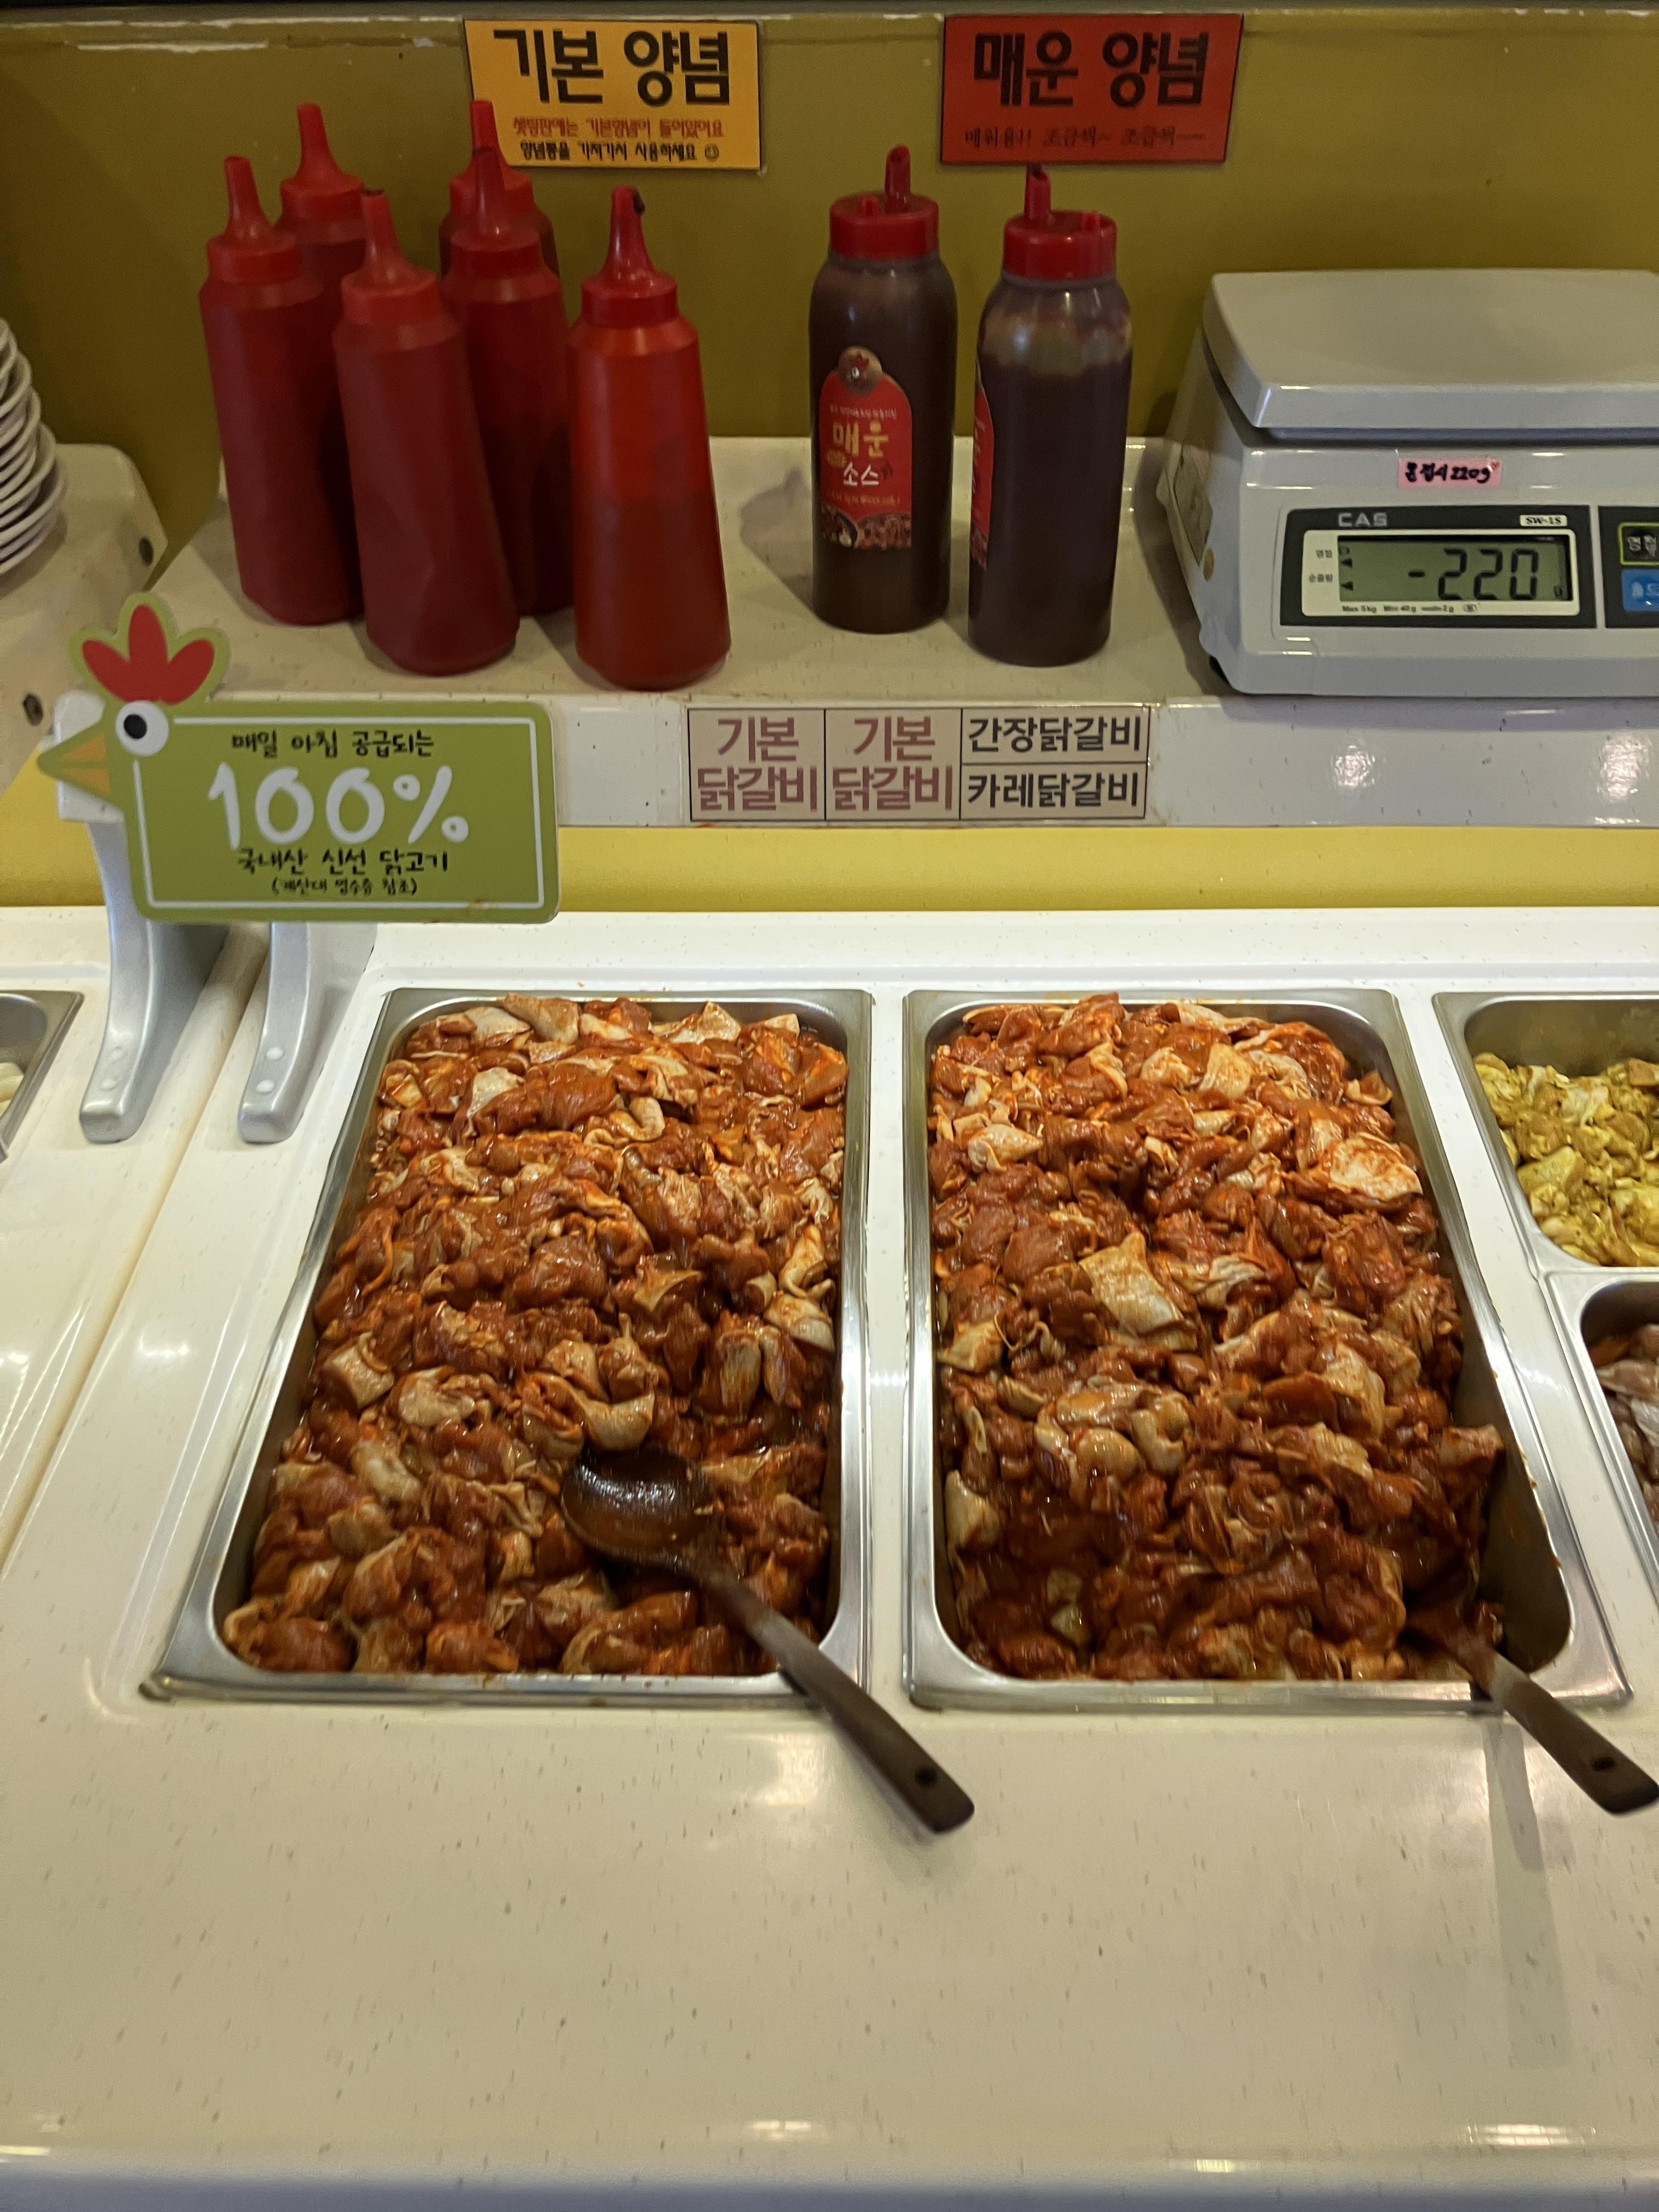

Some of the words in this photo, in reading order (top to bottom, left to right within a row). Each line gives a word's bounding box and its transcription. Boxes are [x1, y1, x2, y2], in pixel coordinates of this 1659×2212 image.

[494, 29, 603, 104] 기본
[623, 30, 730, 107] 양념
[973, 31, 1079, 106] 매운
[1102, 31, 1210, 108] 양념
[585, 117, 651, 139] 기본양념이
[659, 117, 725, 139] 들어있어요
[635, 140, 698, 162] 사용하세요
[832, 420, 889, 458] 매운
[843, 461, 879, 487] 소스
[1338, 512, 1388, 528] CAS
[1407, 548, 1539, 601] -220
[232, 728, 278, 759] 매일
[291, 729, 338, 759] 아침
[352, 729, 435, 758] 공급되는
[716, 716, 799, 763] 기본
[853, 716, 935, 763] 기본
[968, 716, 1141, 753] 간장닭갈비
[207, 761, 470, 851] 100%
[697, 765, 817, 813] 닭갈비
[832, 764, 953, 812] 닭갈비
[967, 772, 1139, 808] 카레닭갈비
[238, 847, 309, 876] 국내산
[321, 848, 366, 876] 신선
[379, 848, 448, 876] 닭고기
